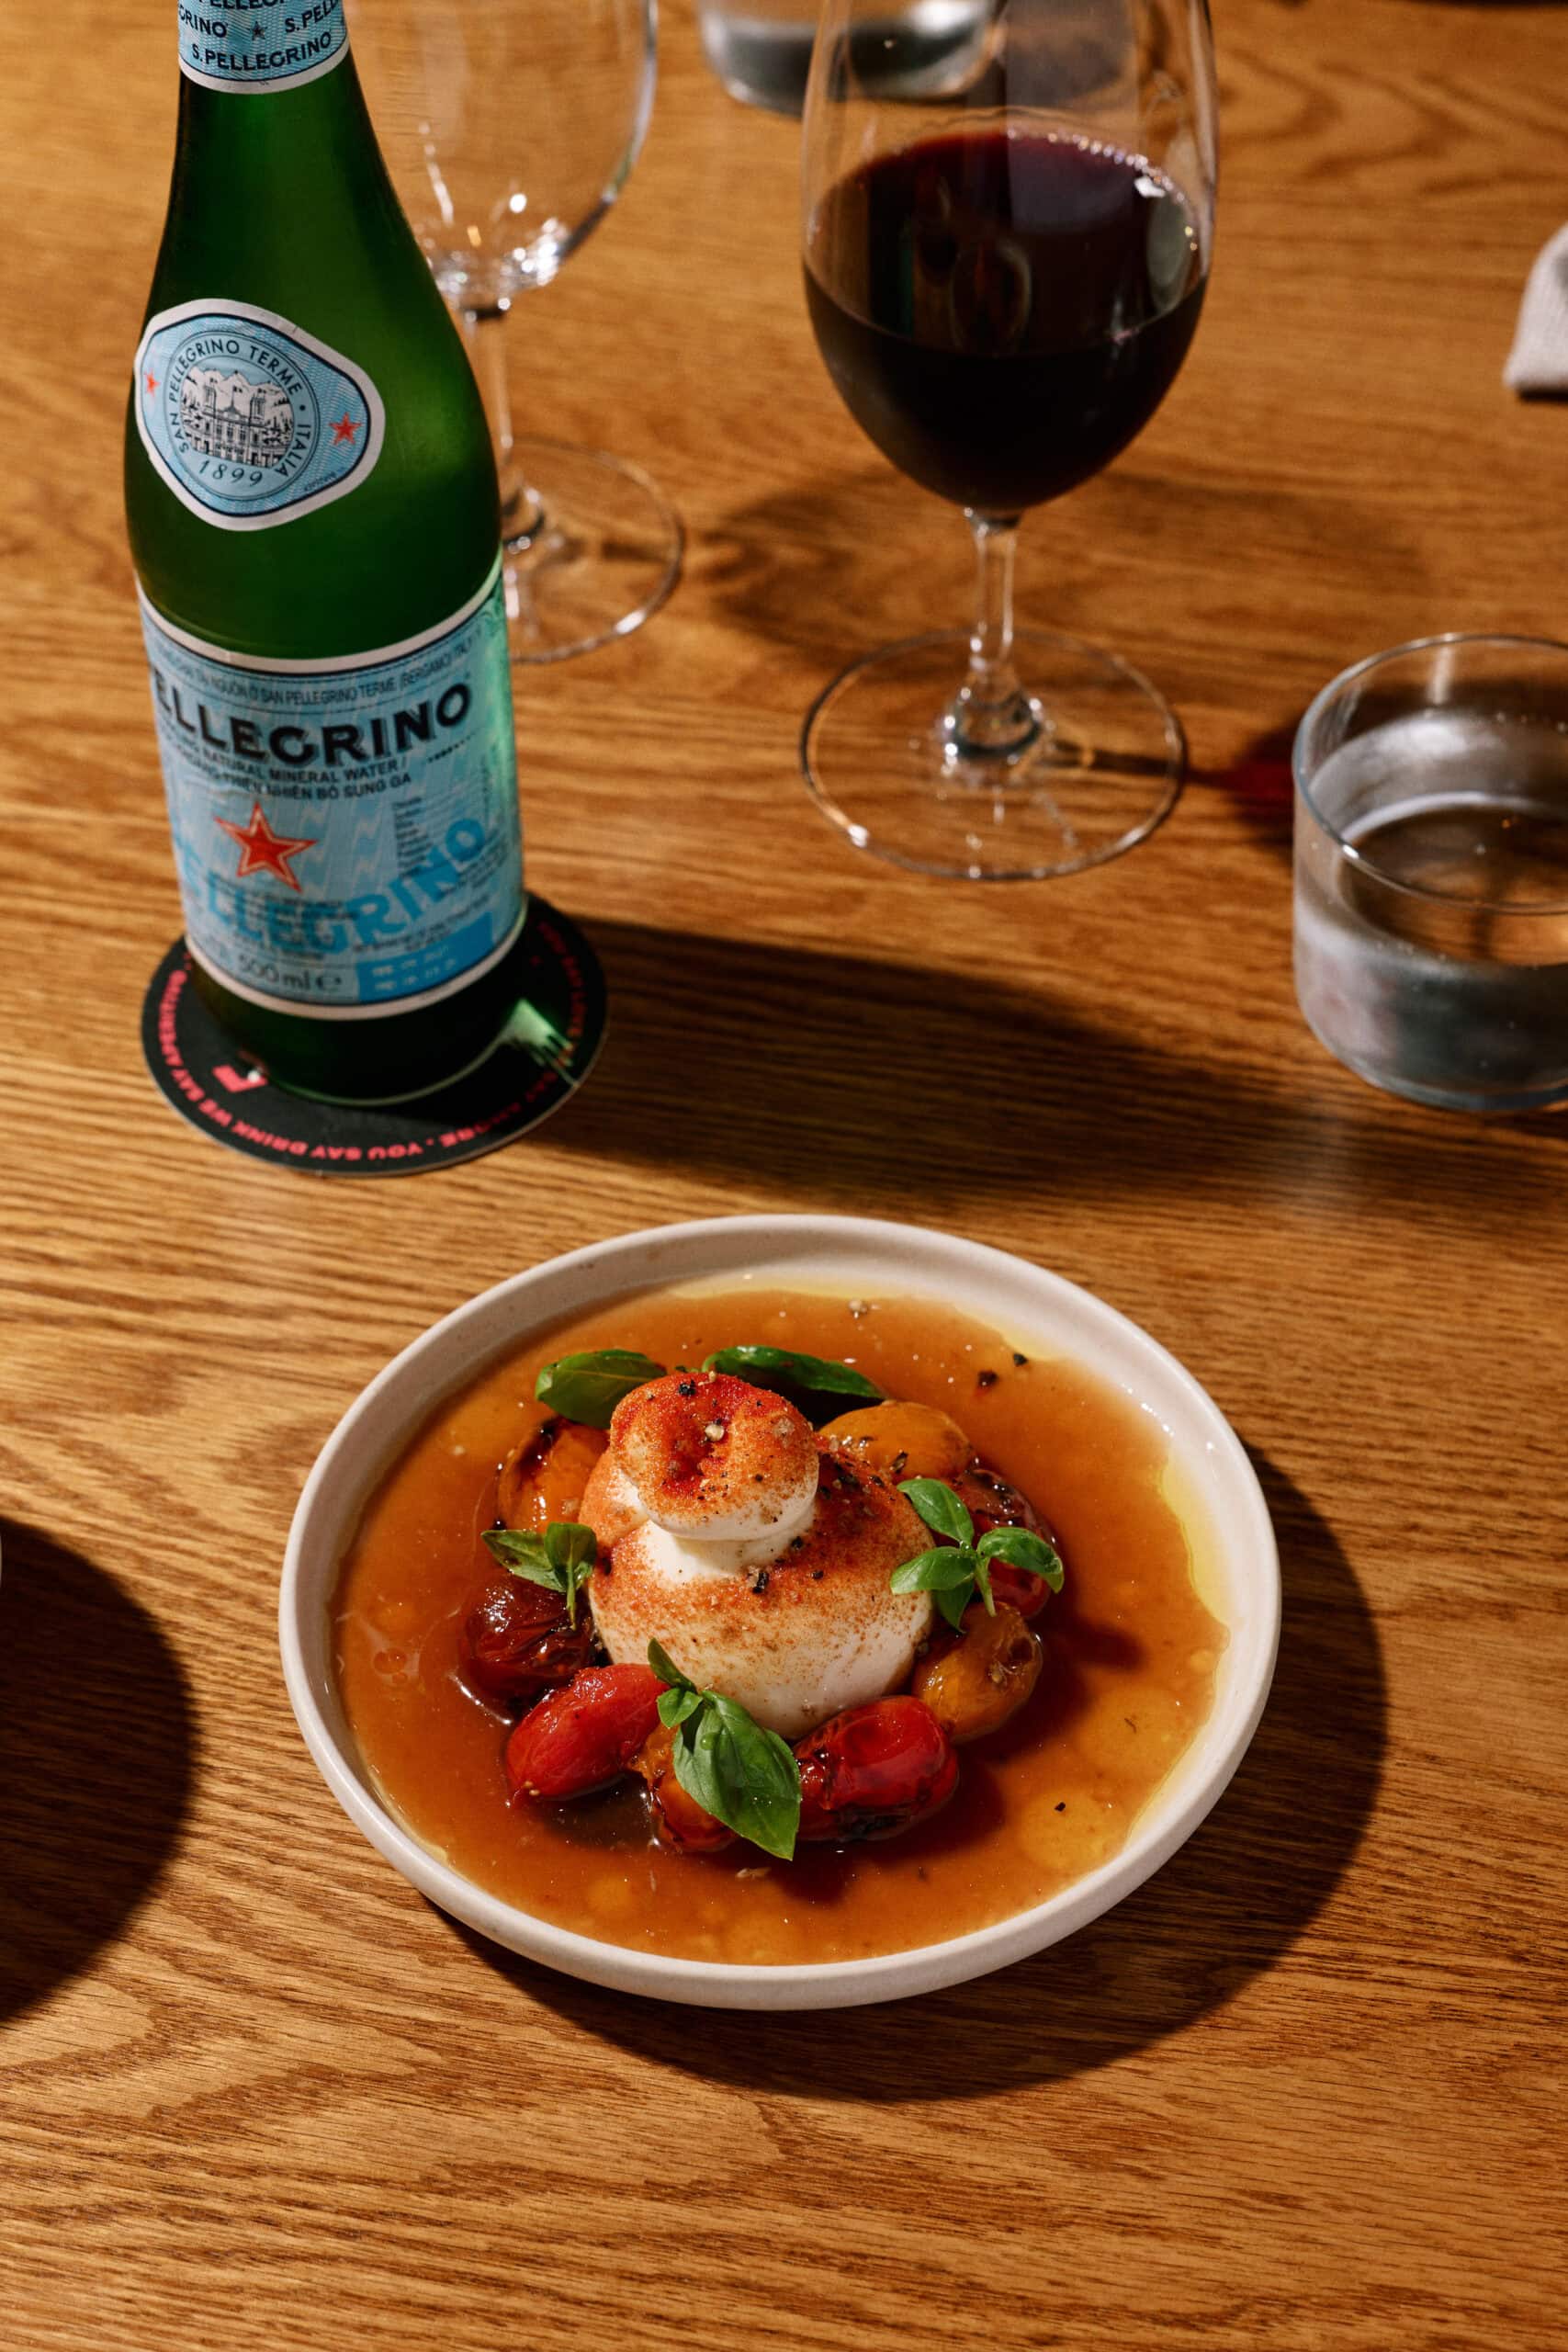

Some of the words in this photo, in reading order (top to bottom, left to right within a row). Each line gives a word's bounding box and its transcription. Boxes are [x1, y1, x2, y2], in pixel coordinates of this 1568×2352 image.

[192, 30, 332, 72] S.PELLEGRINO
[168, 338, 241, 403] PELLEGRINO
[249, 345, 303, 397] TERME
[168, 413, 190, 455] SAN
[275, 423, 312, 479] ITALIA
[197, 459, 263, 487] 1899
[285, 684, 357, 707] PELLEGRINO
[269, 767, 338, 783] MINERAL
[344, 759, 398, 782] WATER
[344, 779, 387, 797] SUNG
[389, 772, 412, 789] GA
[170, 1068, 206, 1102] SAY
[197, 1098, 233, 1127] WE
[231, 1118, 310, 1158] DRINK
[310, 1145, 363, 1162] SAY
[367, 1141, 424, 1161] YOU
